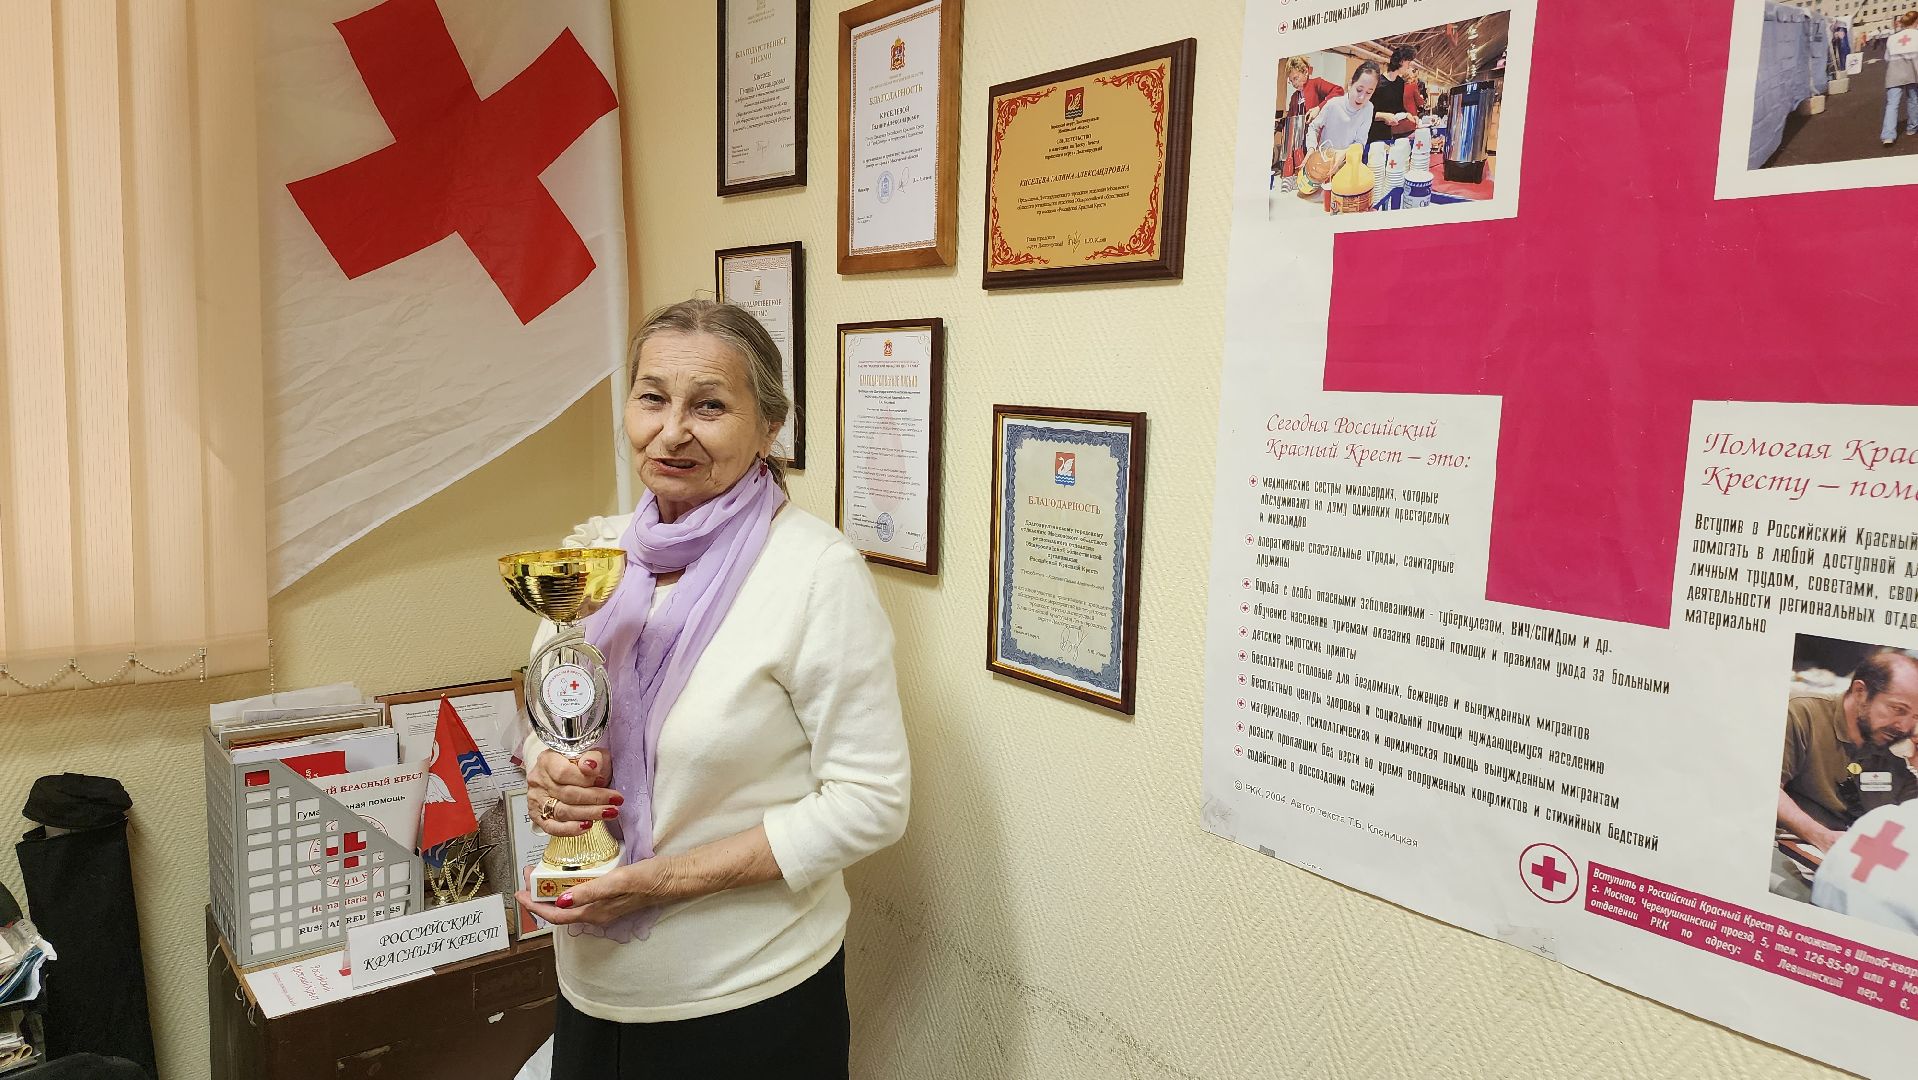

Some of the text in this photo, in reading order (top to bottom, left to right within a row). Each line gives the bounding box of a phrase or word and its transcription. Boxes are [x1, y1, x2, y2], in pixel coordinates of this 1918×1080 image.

[1266, 413, 1439, 441] Сегодня Российский
[1265, 438, 1471, 469] Красный Крест это:
[1702, 432, 1832, 460] Помогая
[1314, 480, 1342, 496] сестры
[1402, 488, 1439, 506] которые
[1702, 466, 1918, 501] Кресту пом
[1028, 495, 1101, 515] БЛАГОДАРНОСТЬ
[1394, 507, 1450, 526] престарелых
[1694, 512, 1744, 536] Вступив
[1752, 521, 1760, 536] в
[1766, 519, 1847, 544] Российский
[1256, 553, 1290, 568] дружины
[1308, 542, 1362, 561] спасательные
[1366, 550, 1398, 568] отряды,
[1404, 554, 1455, 574] санитарные
[1692, 538, 1896, 576] помогать в любой доступной
[1689, 562, 1739, 582] личным
[1746, 568, 1800, 591] трудом,
[1808, 575, 1879, 600] советами,
[1255, 578, 1279, 595] борьба
[1316, 590, 1357, 608] опасными
[1360, 596, 1425, 620] заболеваниями
[1438, 610, 1505, 636] туберкулезом,
[1511, 620, 1577, 647] ВИЧ/СПИДом
[1583, 636, 1590, 648] и
[1596, 638, 1612, 656] др.
[1684, 608, 1768, 634] материально
[1686, 584, 1918, 630] деятельности региональных отде
[1252, 628, 1282, 645] детские
[1372, 626, 1411, 645] оказания
[1450, 640, 1486, 660] помощи
[1492, 649, 1498, 662] и
[1503, 651, 1551, 672] правилам
[1556, 660, 1586, 680] ухода
[1592, 668, 1605, 682] за
[1611, 668, 1670, 694] больными
[1297, 662, 1333, 681] столовые
[1336, 671, 1350, 685] для
[1354, 673, 1402, 698] бездомных,
[1407, 684, 1449, 708] беженцев
[1453, 698, 1460, 710] и
[1464, 700, 1531, 727] вынужденных
[1536, 716, 1590, 740] мигрантов
[1375, 706, 1423, 730] социальной
[1426, 719, 1464, 740] помощи
[1468, 729, 1544, 760] нуждающемуся
[1548, 749, 1606, 775] населению
[340, 777, 391, 793] КРАСНЫЙ
[394, 772, 424, 784] КРЕСТ
[1298, 763, 1346, 788] воссоздании
[1350, 779, 1376, 797] семей
[1374, 733, 1380, 745] и
[1384, 735, 1439, 762] юридическая
[1442, 751, 1479, 773] помощь
[1484, 762, 1556, 792] вынужденным
[1561, 782, 1620, 810] мигрантам
[368, 795, 406, 808] помощь
[1407, 768, 1466, 797] вооруженных
[1471, 786, 1528, 814] конфликтов
[1534, 804, 1540, 818] и
[1545, 808, 1602, 836] стихийных
[1607, 822, 1660, 852] бедствий
[1290, 798, 1316, 815] Автор
[1367, 822, 1419, 848] Кленицкая
[380, 910, 484, 947] РОССИЙСКИЙ
[1592, 868, 1637, 890] Вступить
[1638, 884, 1645, 893] в
[1647, 884, 1698, 909] Российский
[1699, 900, 1742, 922] Красный
[1743, 914, 1775, 934] Крест
[1776, 924, 1793, 939] Вы
[1854, 948, 1918, 979] Штаб-квар
[1592, 884, 1600, 894] г.
[1603, 886, 1637, 906] Москва,
[1641, 898, 1718, 931] Черемушкинский
[1720, 924, 1756, 944] проезд,
[1760, 936, 1770, 948] 5,
[1774, 942, 1799, 958] тел.
[1804, 950, 1860, 976] 126-85-90
[363, 924, 502, 971] КРАСНЫЙ КРЕСТ
[1590, 899, 1638, 921] отделении
[1650, 916, 1670, 931] РКК
[1680, 928, 1693, 939] по
[1705, 936, 1742, 956] адресу:
[1754, 950, 1765, 963] Б.
[1777, 958, 1844, 990] Левшинский
